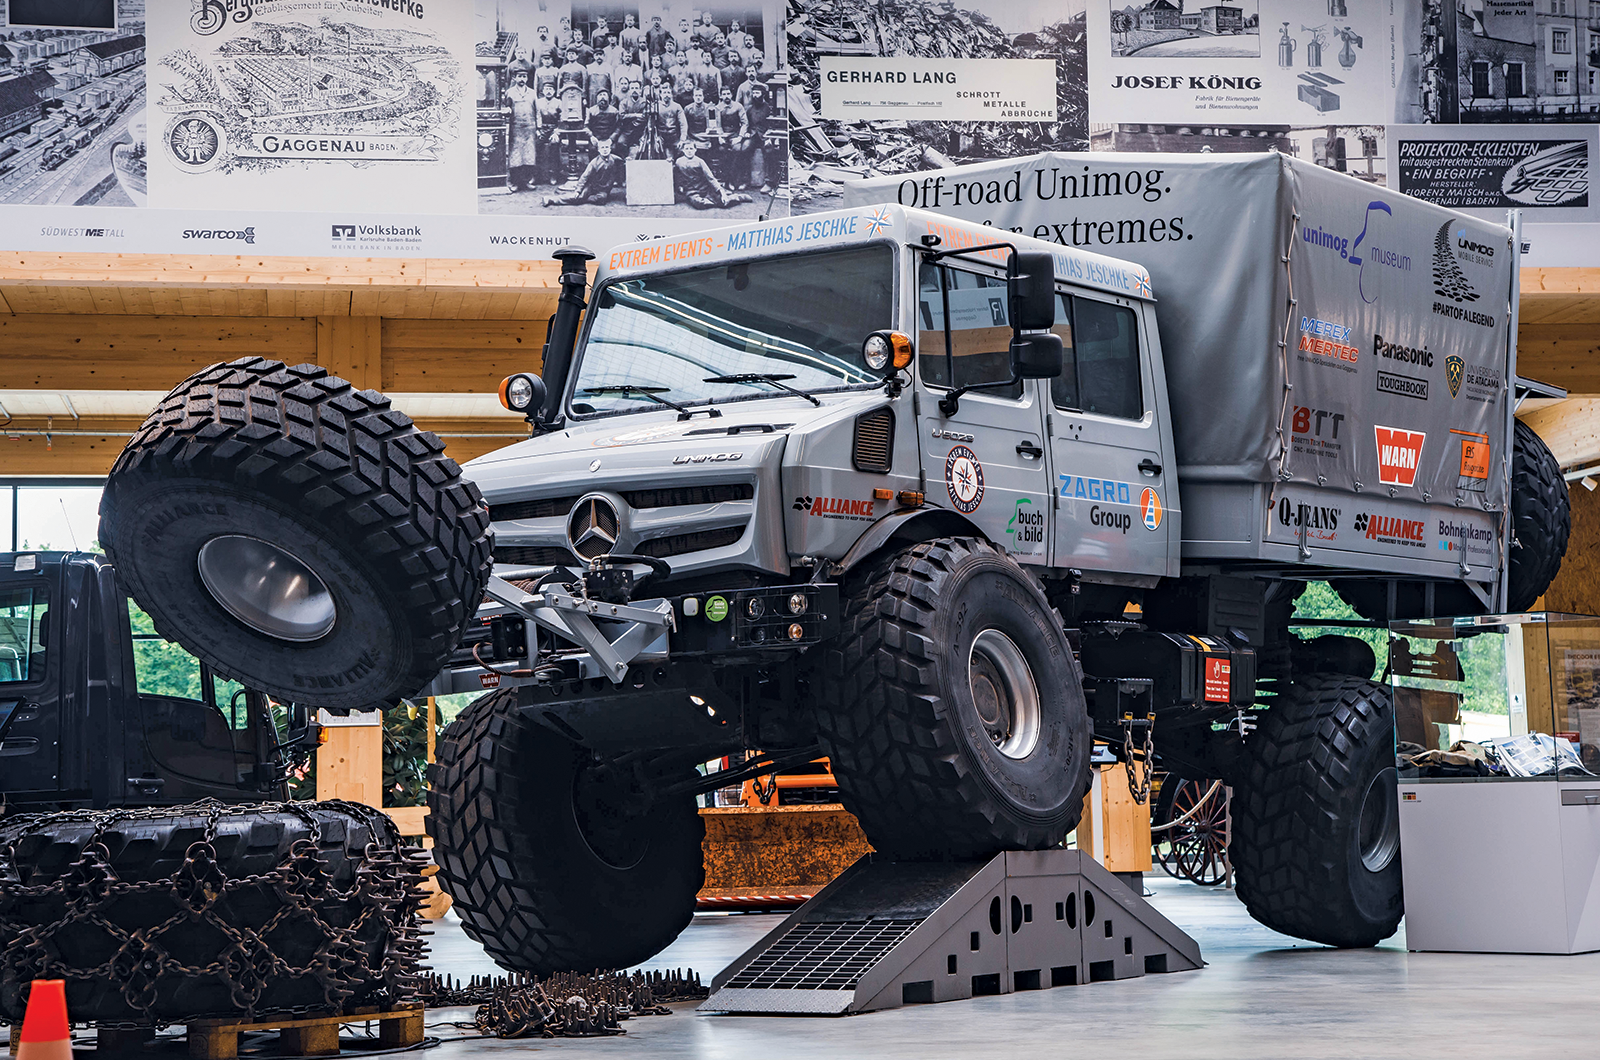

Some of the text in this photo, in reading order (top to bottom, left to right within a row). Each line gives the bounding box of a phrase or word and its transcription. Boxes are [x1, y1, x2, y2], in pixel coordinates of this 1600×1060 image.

[827, 70, 957, 84] GERHARD LANG
[1111, 75, 1262, 90] JOSEF KÖNIG
[1001, 110, 1053, 118] ABBRÜCHE
[262, 136, 366, 153] GAGGENAU
[1400, 143, 1540, 157] PROTEKTOR-ECKLEISTEN
[1473, 157, 1514, 167] Schenkeln
[1412, 168, 1486, 179] EIN BEGRIFF
[898, 165, 1171, 209] Off-road Unimog.
[1405, 189, 1445, 197] FLORENZ
[1462, 197, 1500, 206] (BADEN)
[40, 226, 125, 238] SÜDWESTMETALL
[182, 228, 236, 240] swarco
[359, 225, 422, 236] Volksbank
[1033, 215, 1195, 246] extremes.
[489, 235, 571, 246] WACKENHUT
[610, 215, 859, 271] EXTREM EVENTS MATTHIAS JESCHKE
[1303, 226, 1349, 259] unimog
[1458, 238, 1495, 257] UNIMOG
[1371, 246, 1412, 271] museum
[1458, 250, 1494, 269] MOBILE SERVICE
[1086, 260, 1130, 290] JESCHKE
[1432, 301, 1495, 328] #PARTOFALEGEND
[1300, 316, 1352, 342] MEREX
[1299, 335, 1359, 363] MERTEC
[1373, 334, 1434, 368] Panasonic
[1380, 376, 1427, 396] TOUGHBOOK
[1467, 374, 1500, 389] DE ATACAMA
[1292, 405, 1344, 439] BTT
[672, 452, 743, 464] UNIMOG
[1382, 444, 1416, 469] WARN
[1059, 475, 1131, 504] ZAGRO
[809, 497, 875, 517] ALLIANCE
[1018, 508, 1043, 526] buch
[1090, 505, 1131, 534] Group
[1017, 527, 1043, 543] & bild
[1365, 514, 1425, 541] ALLIANCE
[482, 676, 499, 684] WARN
